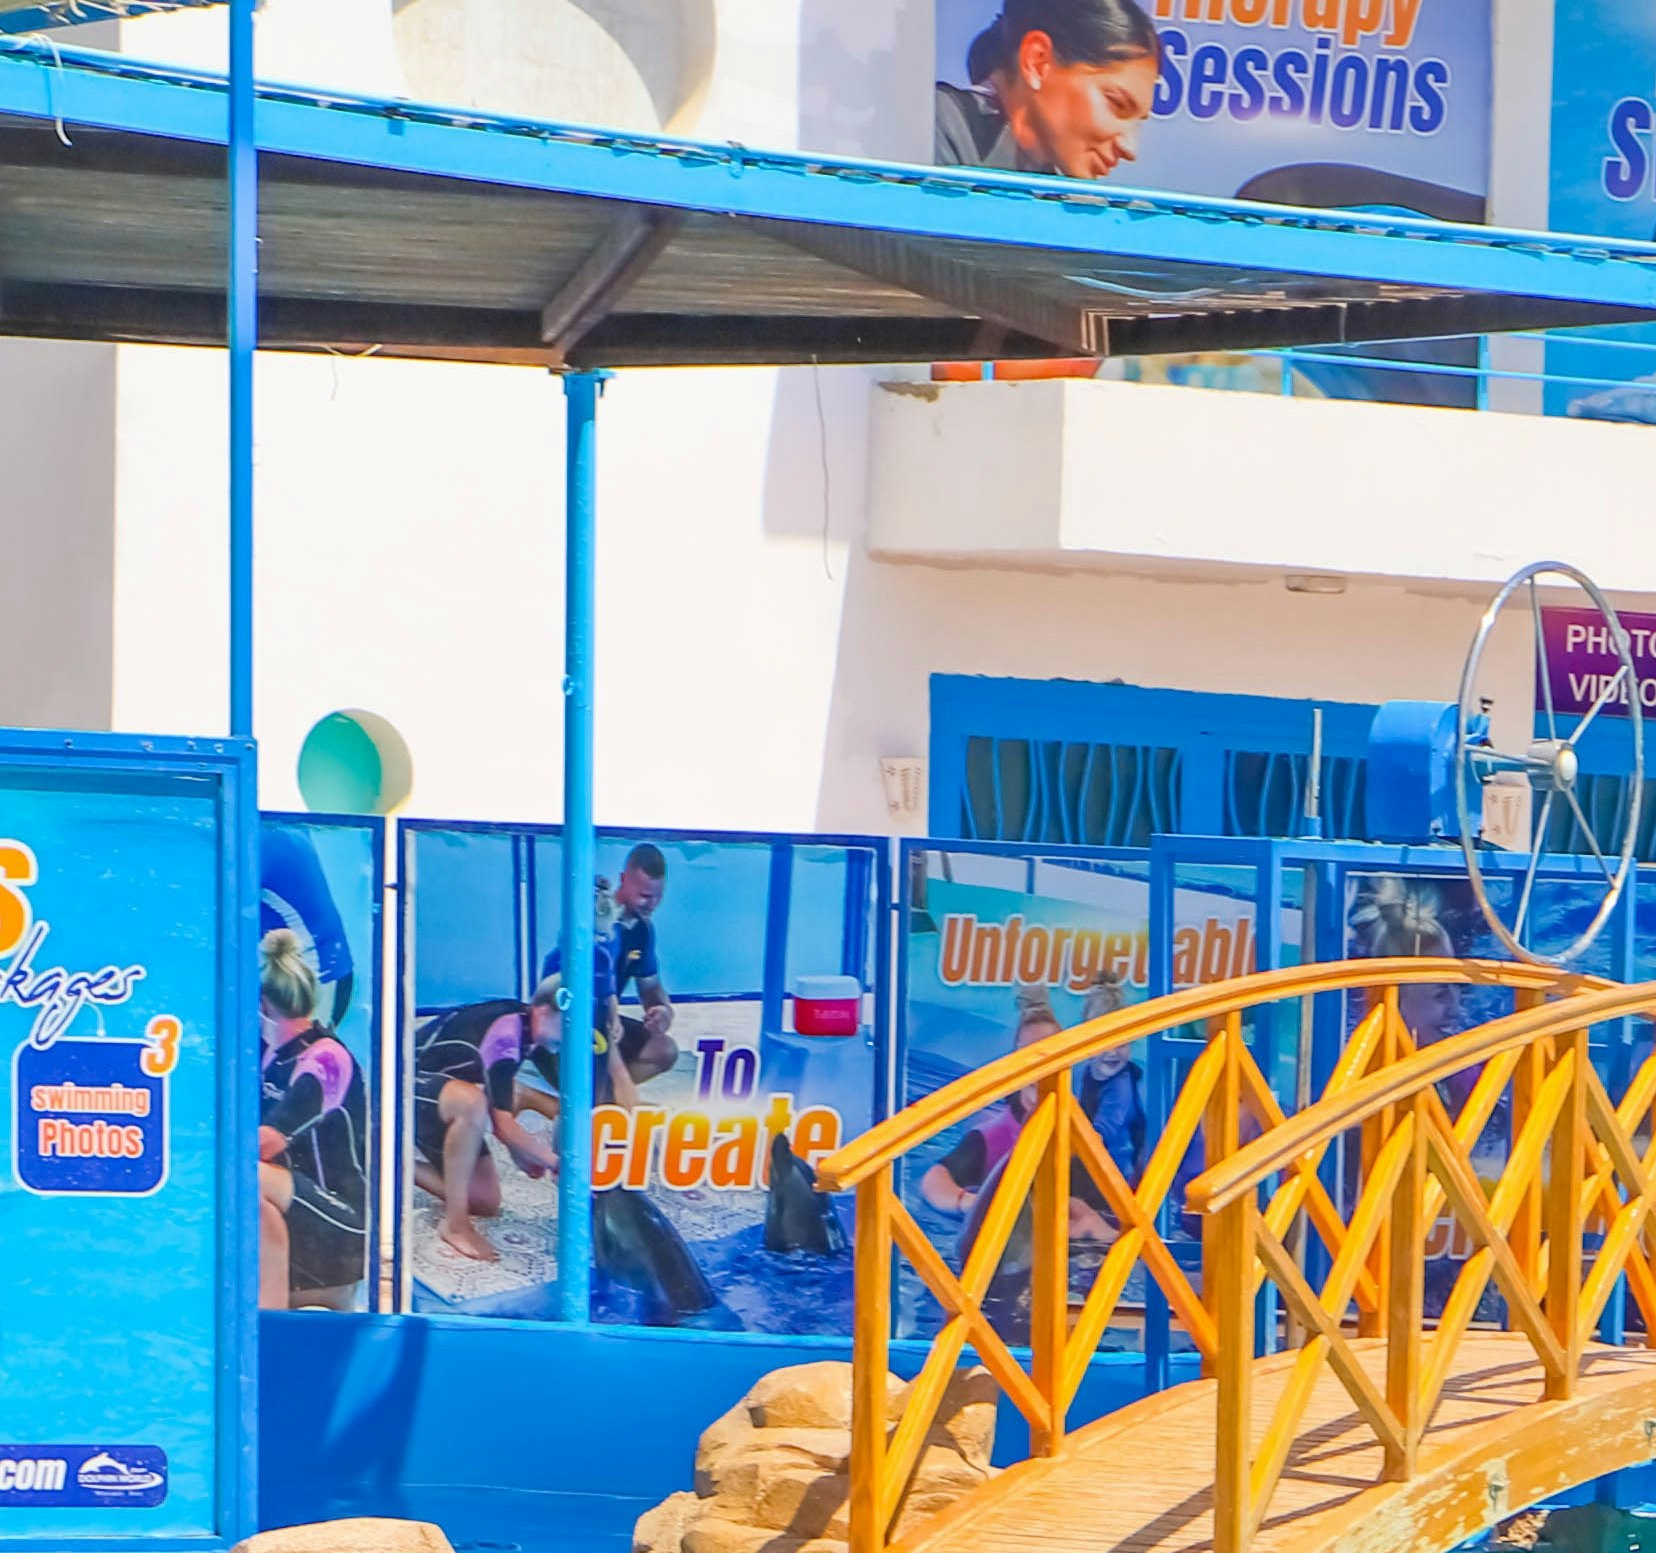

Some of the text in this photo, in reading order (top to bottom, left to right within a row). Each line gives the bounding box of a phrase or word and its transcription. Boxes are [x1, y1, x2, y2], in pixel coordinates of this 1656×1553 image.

[1151, 28, 1449, 134] Sessions
[1, 923, 144, 1046] kages
[143, 1016, 179, 1075] 3
[696, 1039, 758, 1101] To
[31, 1083, 150, 1116] swimming
[39, 1119, 143, 1157] Photos
[591, 1096, 840, 1188] create
